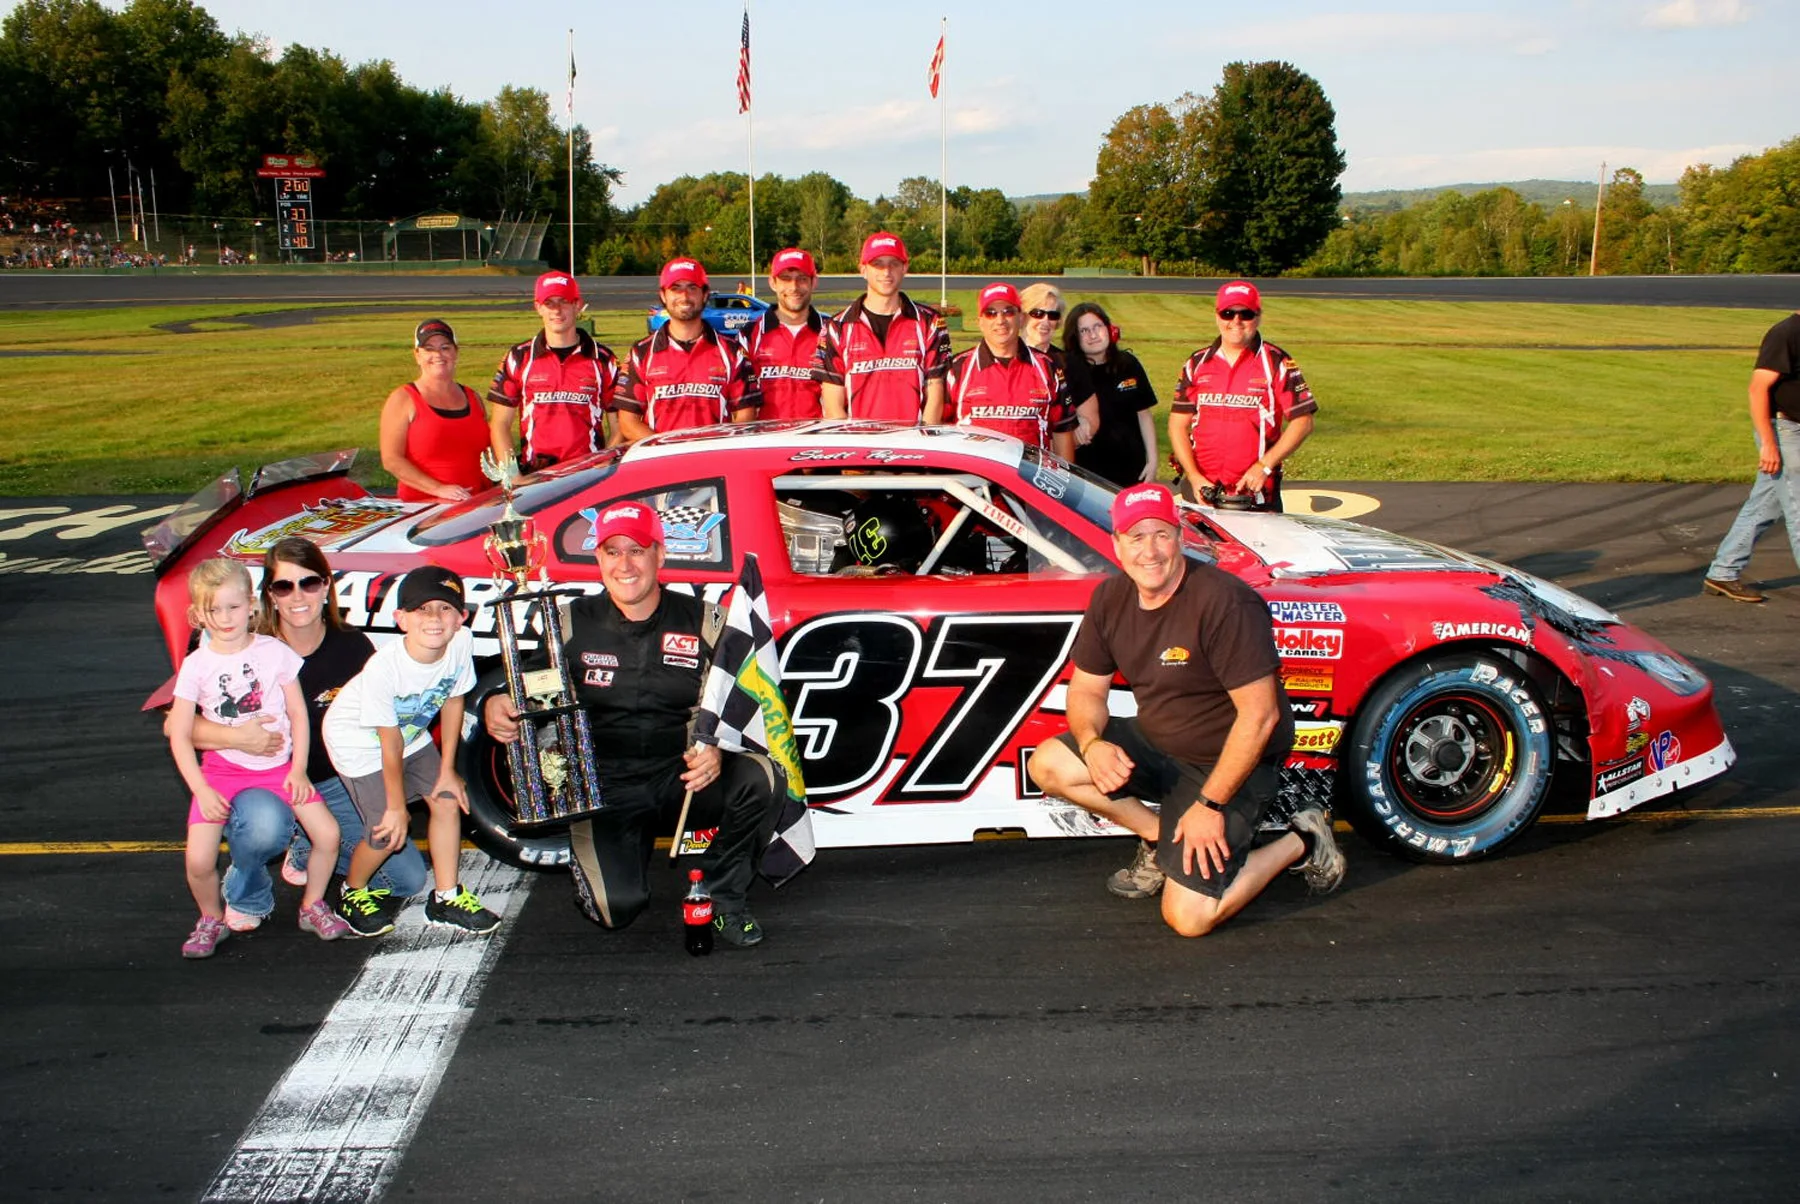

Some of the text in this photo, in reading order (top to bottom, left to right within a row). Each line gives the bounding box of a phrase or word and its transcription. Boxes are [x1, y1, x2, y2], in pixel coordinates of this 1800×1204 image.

[290, 208, 306, 220] 37
[283, 224, 289, 233] 2
[284, 238, 290, 247] 3
[851, 357, 918, 374] HARRISON
[533, 391, 593, 404] HARRISON
[654, 382, 722, 399] HARRISON
[970, 405, 1042, 419] HARRISON
[1269, 602, 1338, 615] QUARTER
[1282, 611, 1343, 622] MASTER
[1439, 622, 1530, 642] AMERICAN
[780, 614, 1084, 793] 37
[1469, 662, 1545, 735] RACER
[1295, 730, 1335, 747] sett
[1650, 730, 1672, 771] VP
[1604, 761, 1642, 781] ALLSTAR
[1366, 761, 1477, 857] AMERICAN
